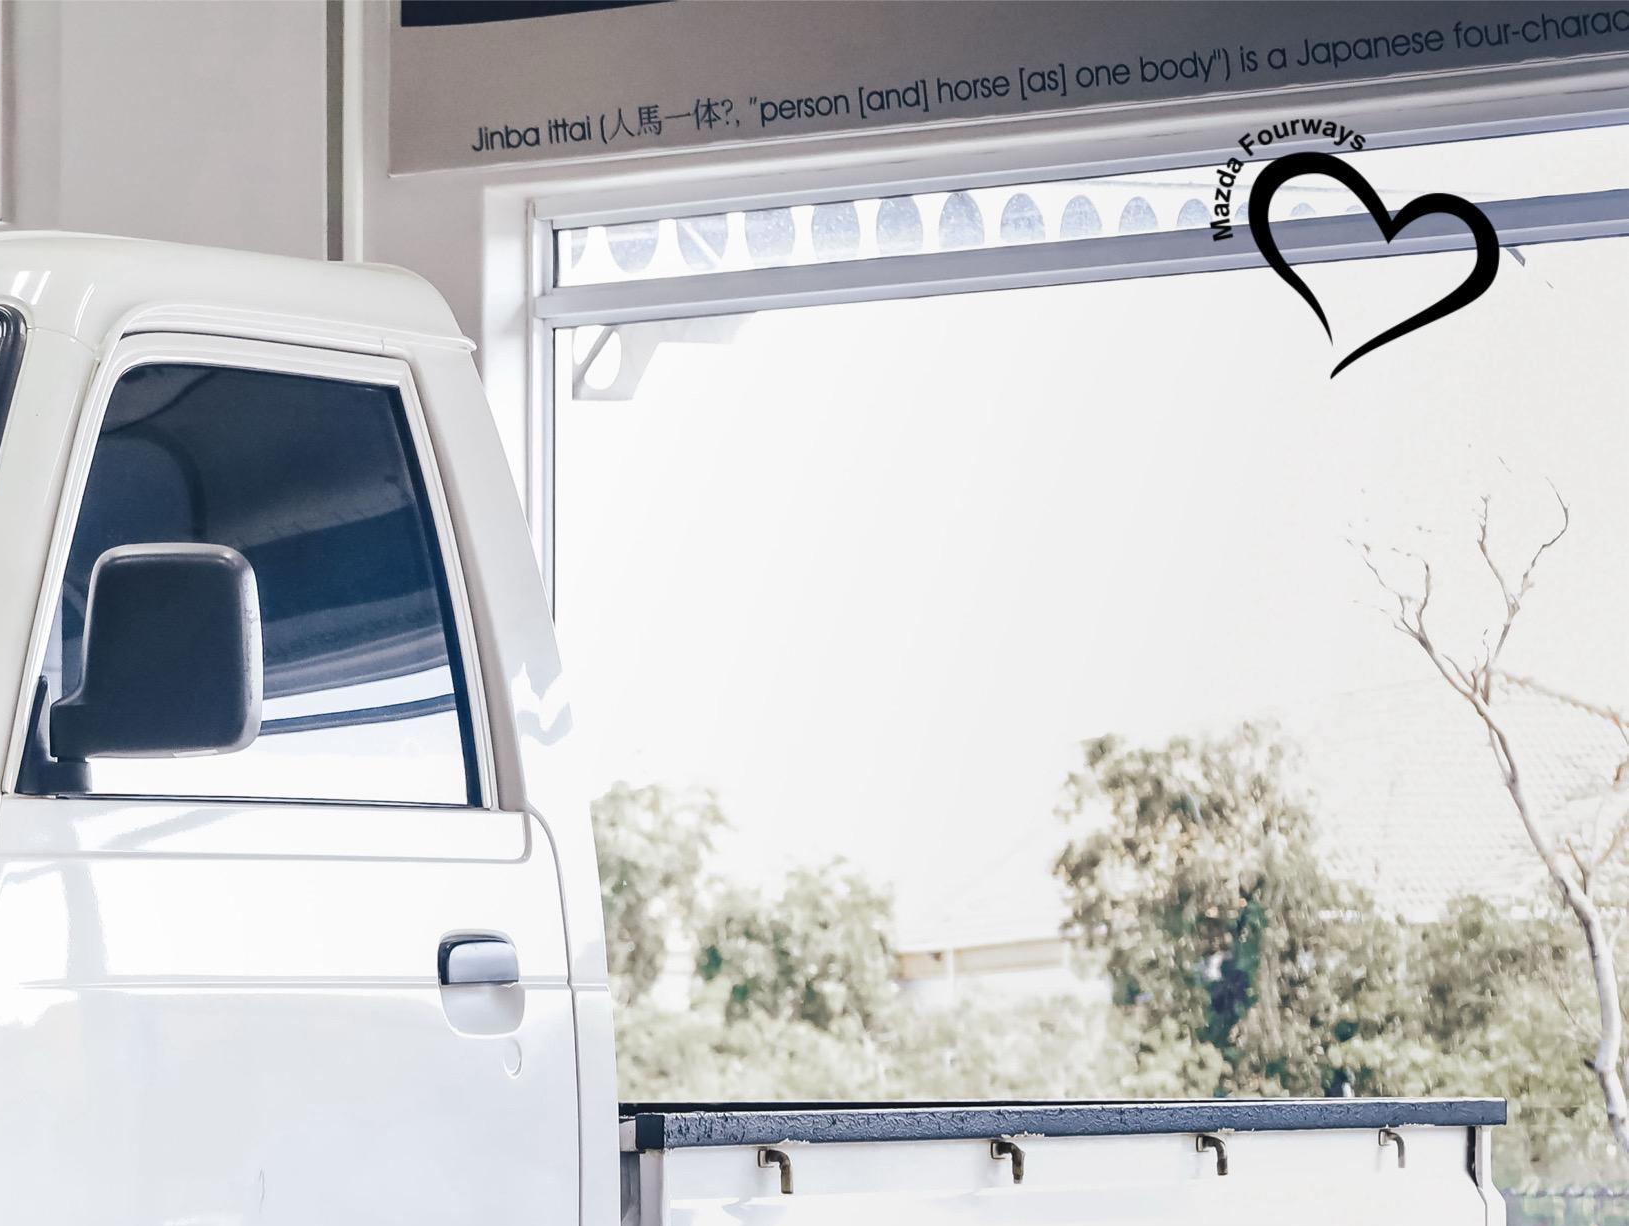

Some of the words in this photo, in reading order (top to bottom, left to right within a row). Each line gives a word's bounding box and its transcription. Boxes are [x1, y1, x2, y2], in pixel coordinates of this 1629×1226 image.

[471, 126, 540, 152] Jinba
[858, 80, 930, 119] [and]
[936, 75, 1011, 103] horse
[1018, 63, 1067, 100] [as]
[1075, 63, 1131, 89] one
[1240, 45, 1259, 73] is
[1267, 46, 1287, 70] a
[1296, 29, 1444, 68] Japanese
[1452, 9, 1629, 49] four-charac
